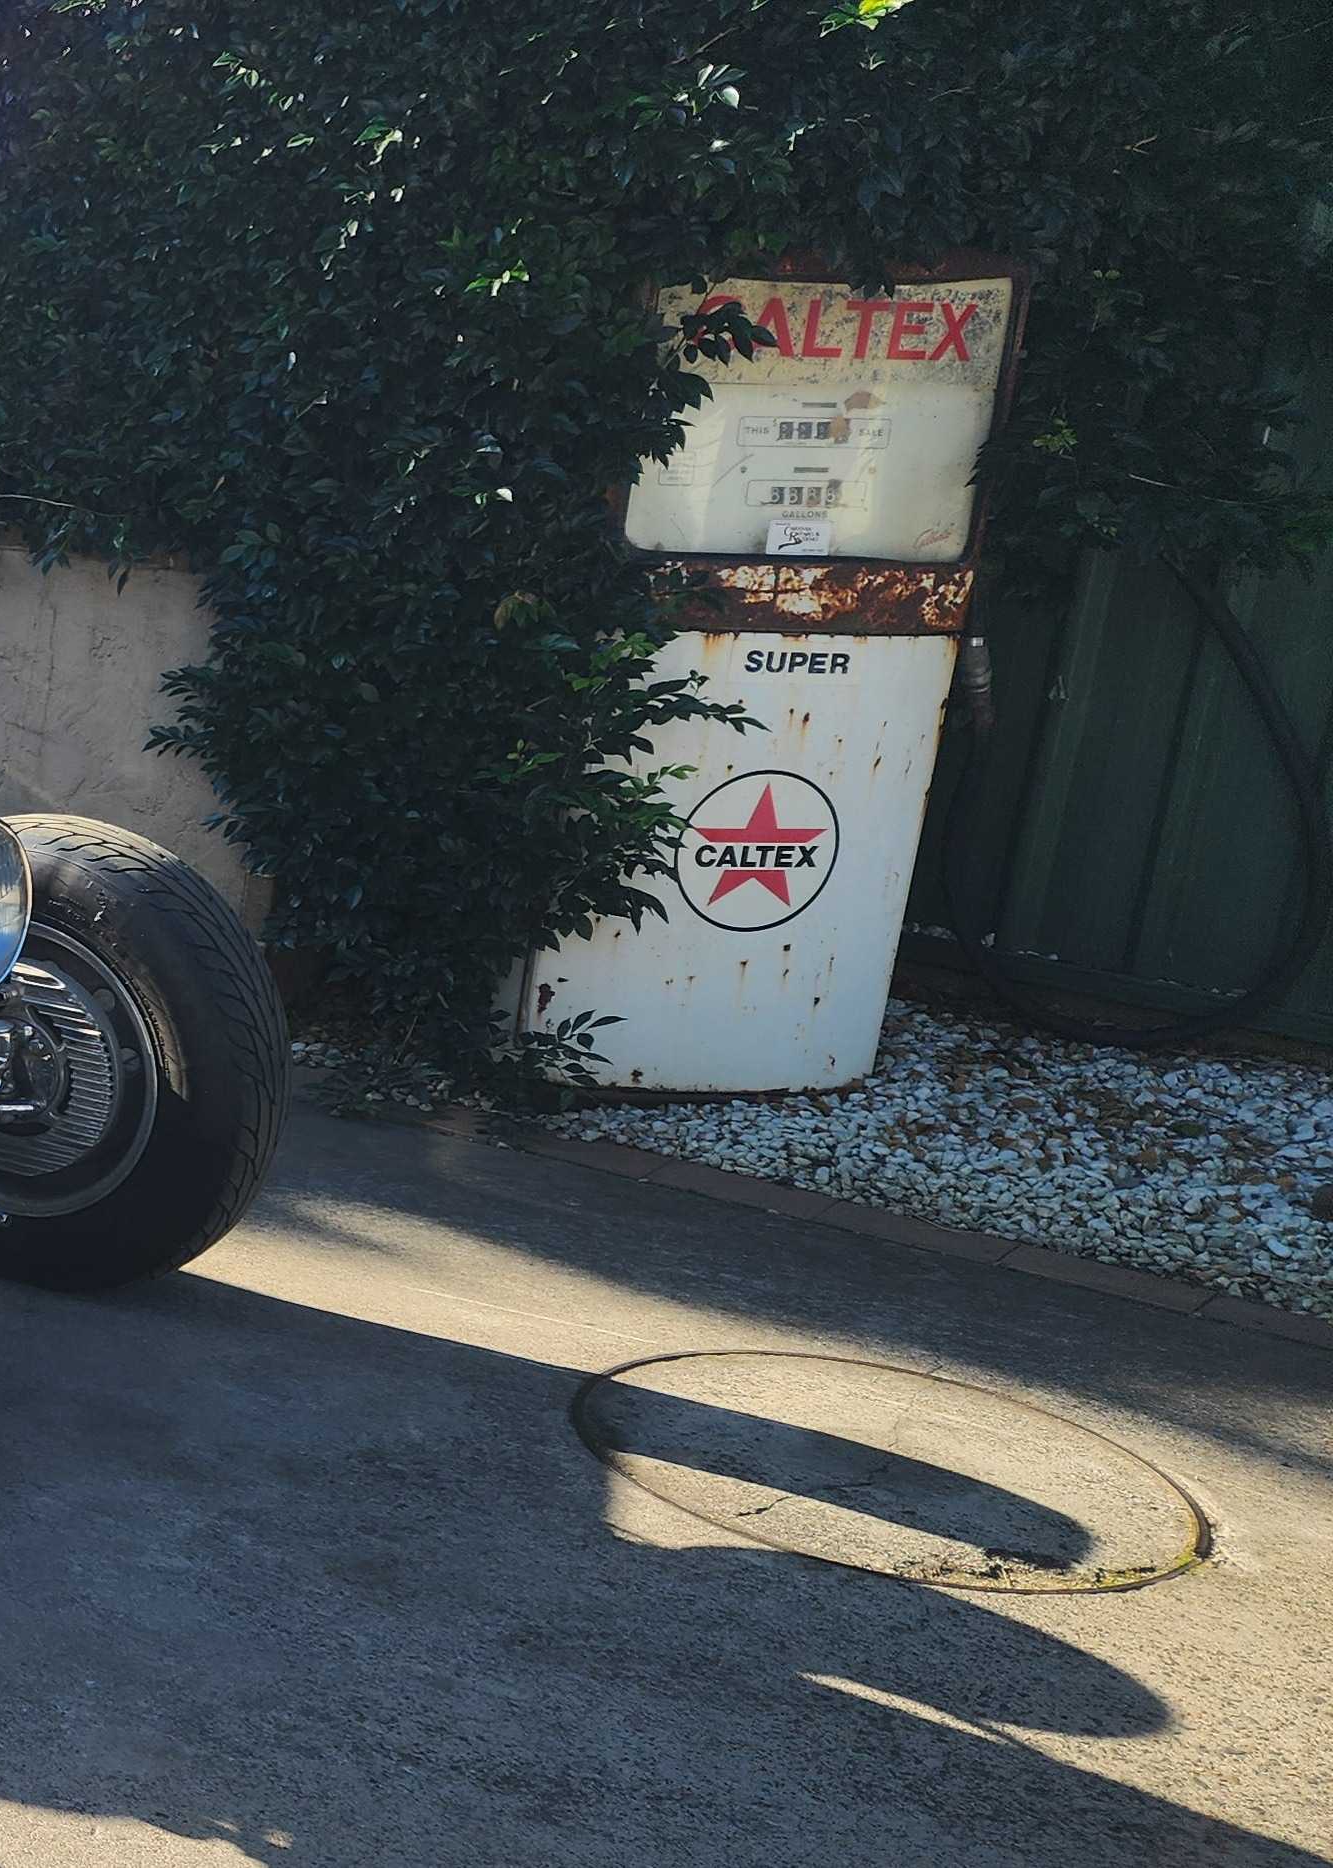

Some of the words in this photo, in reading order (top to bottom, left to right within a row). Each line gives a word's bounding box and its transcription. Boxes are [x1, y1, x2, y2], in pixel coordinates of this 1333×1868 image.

[744, 426, 770, 435] THIS
[858, 428, 884, 437] SALE
[782, 510, 829, 520] GALLONS
[744, 649, 851, 674] SUPER
[694, 844, 820, 868] CALTEX
